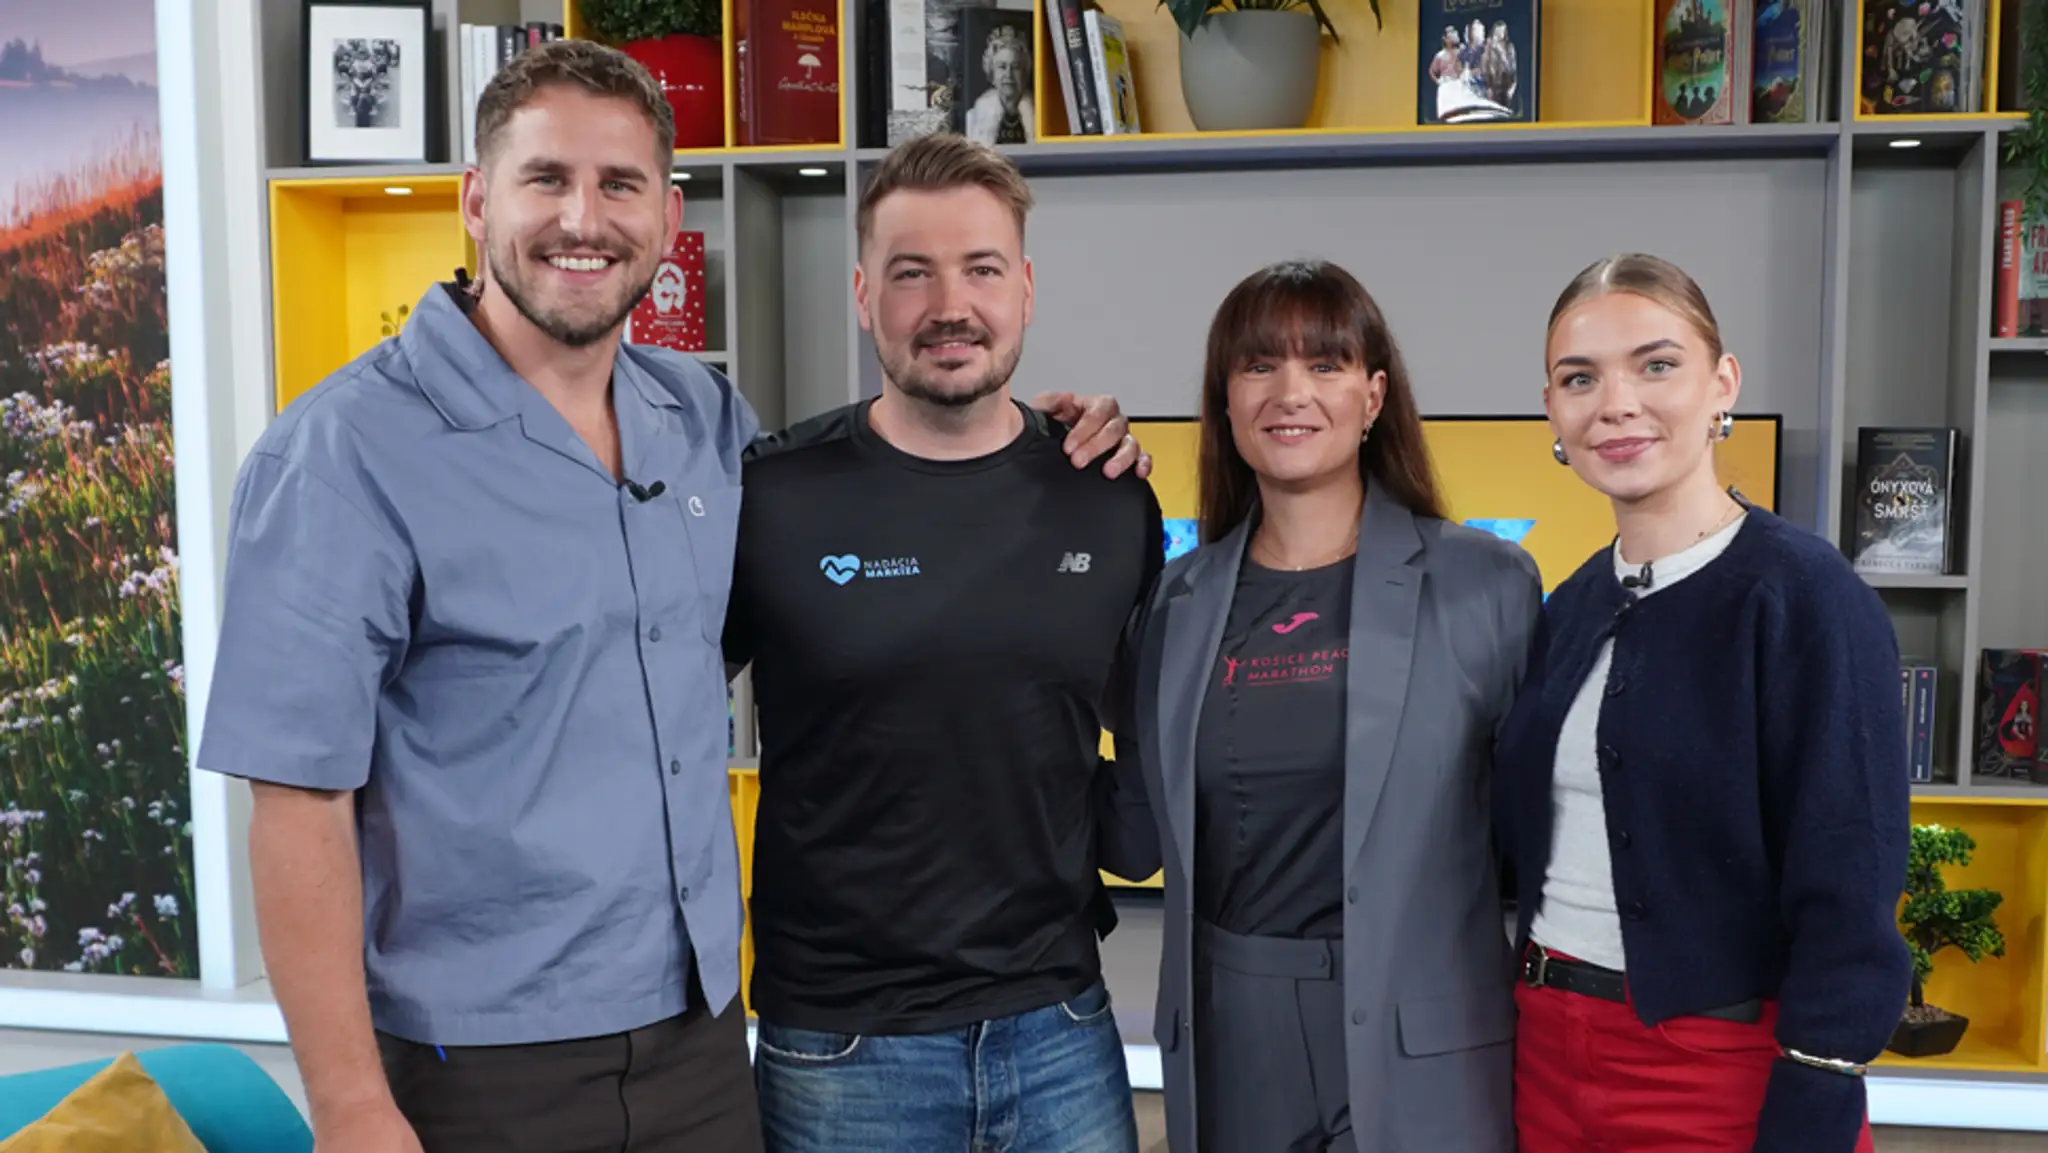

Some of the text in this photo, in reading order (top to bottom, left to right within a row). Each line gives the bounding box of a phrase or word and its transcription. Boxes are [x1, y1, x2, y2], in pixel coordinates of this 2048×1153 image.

[863, 557, 919, 569] NADÁCIA
[1057, 551, 1092, 573] NB
[1247, 663, 1334, 680] MARATHON
